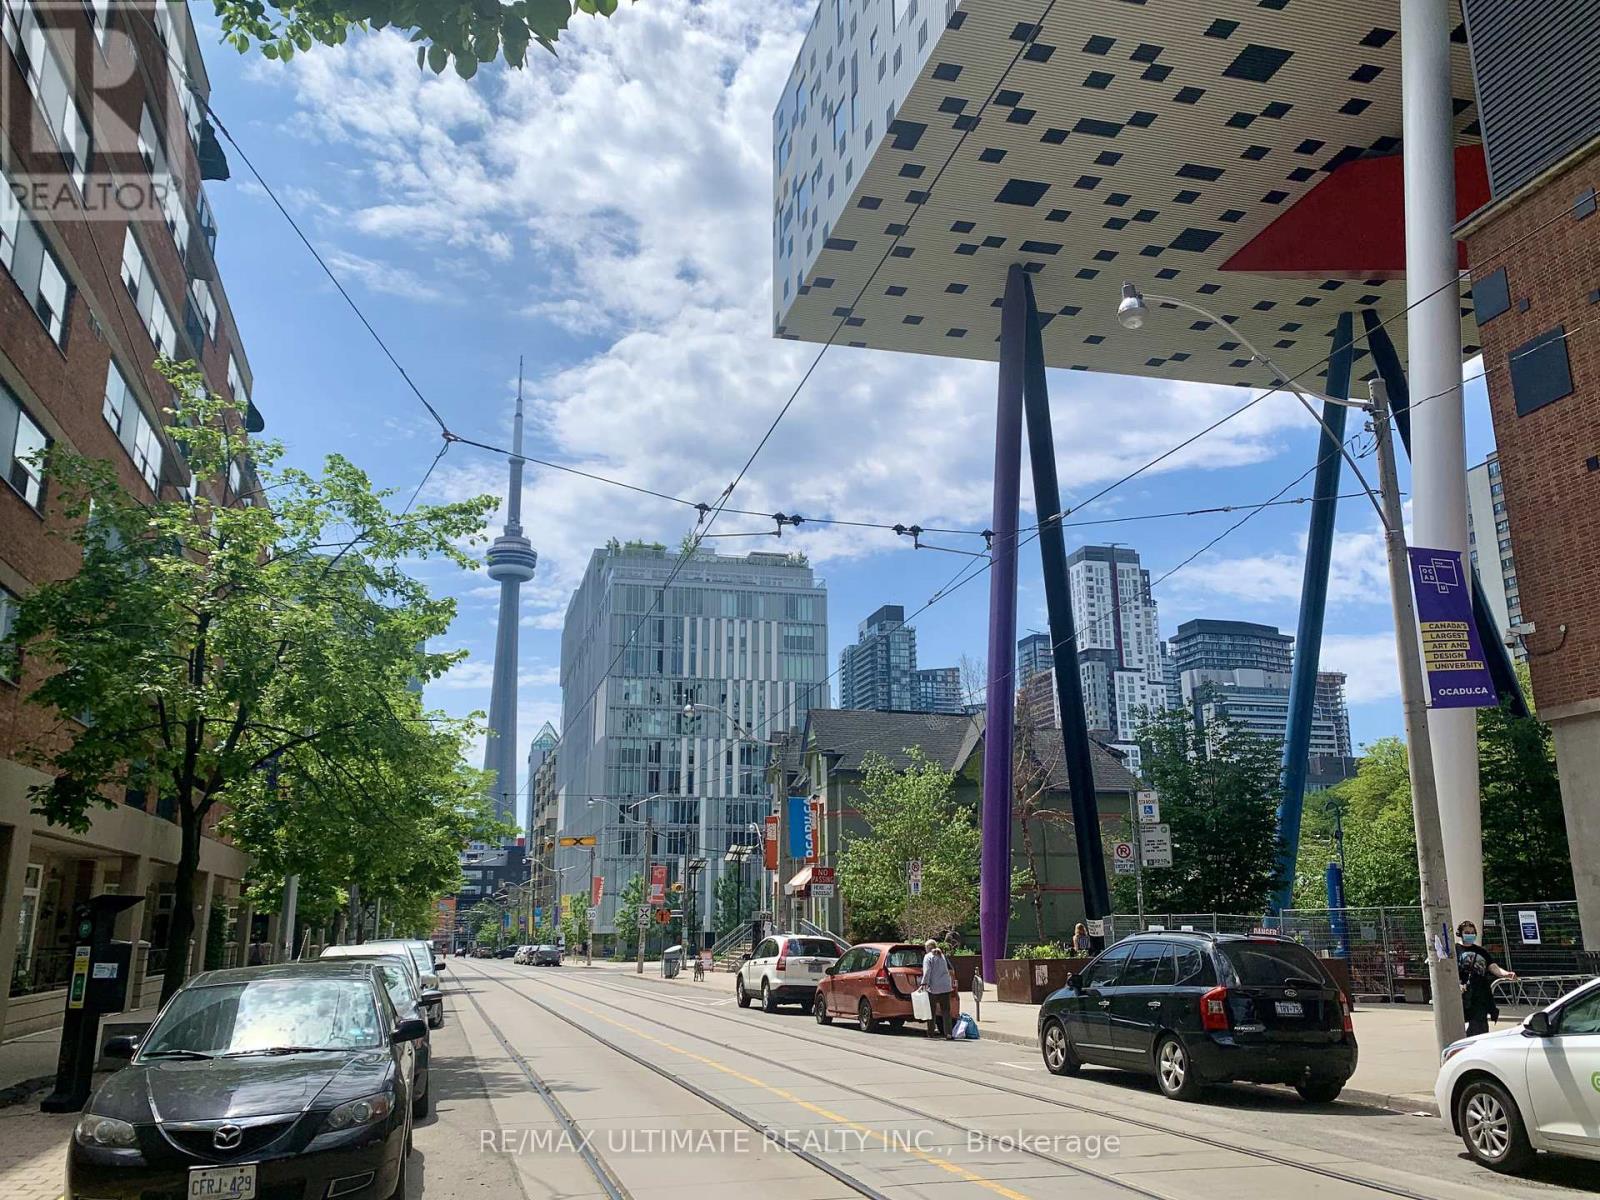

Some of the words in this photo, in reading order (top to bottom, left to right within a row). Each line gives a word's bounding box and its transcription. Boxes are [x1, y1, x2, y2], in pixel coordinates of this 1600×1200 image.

[1428, 622, 1468, 630] CANADA'S
[1430, 632, 1466, 640] LARGEST
[1432, 642, 1449, 650] ART
[1433, 652, 1465, 660] DESIGN
[1434, 662, 1483, 670] UNIVERSITY
[1438, 686, 1489, 697] OCADU.CA
[812, 876, 834, 884] PASSING
[1253, 927, 1277, 936] DANGER
